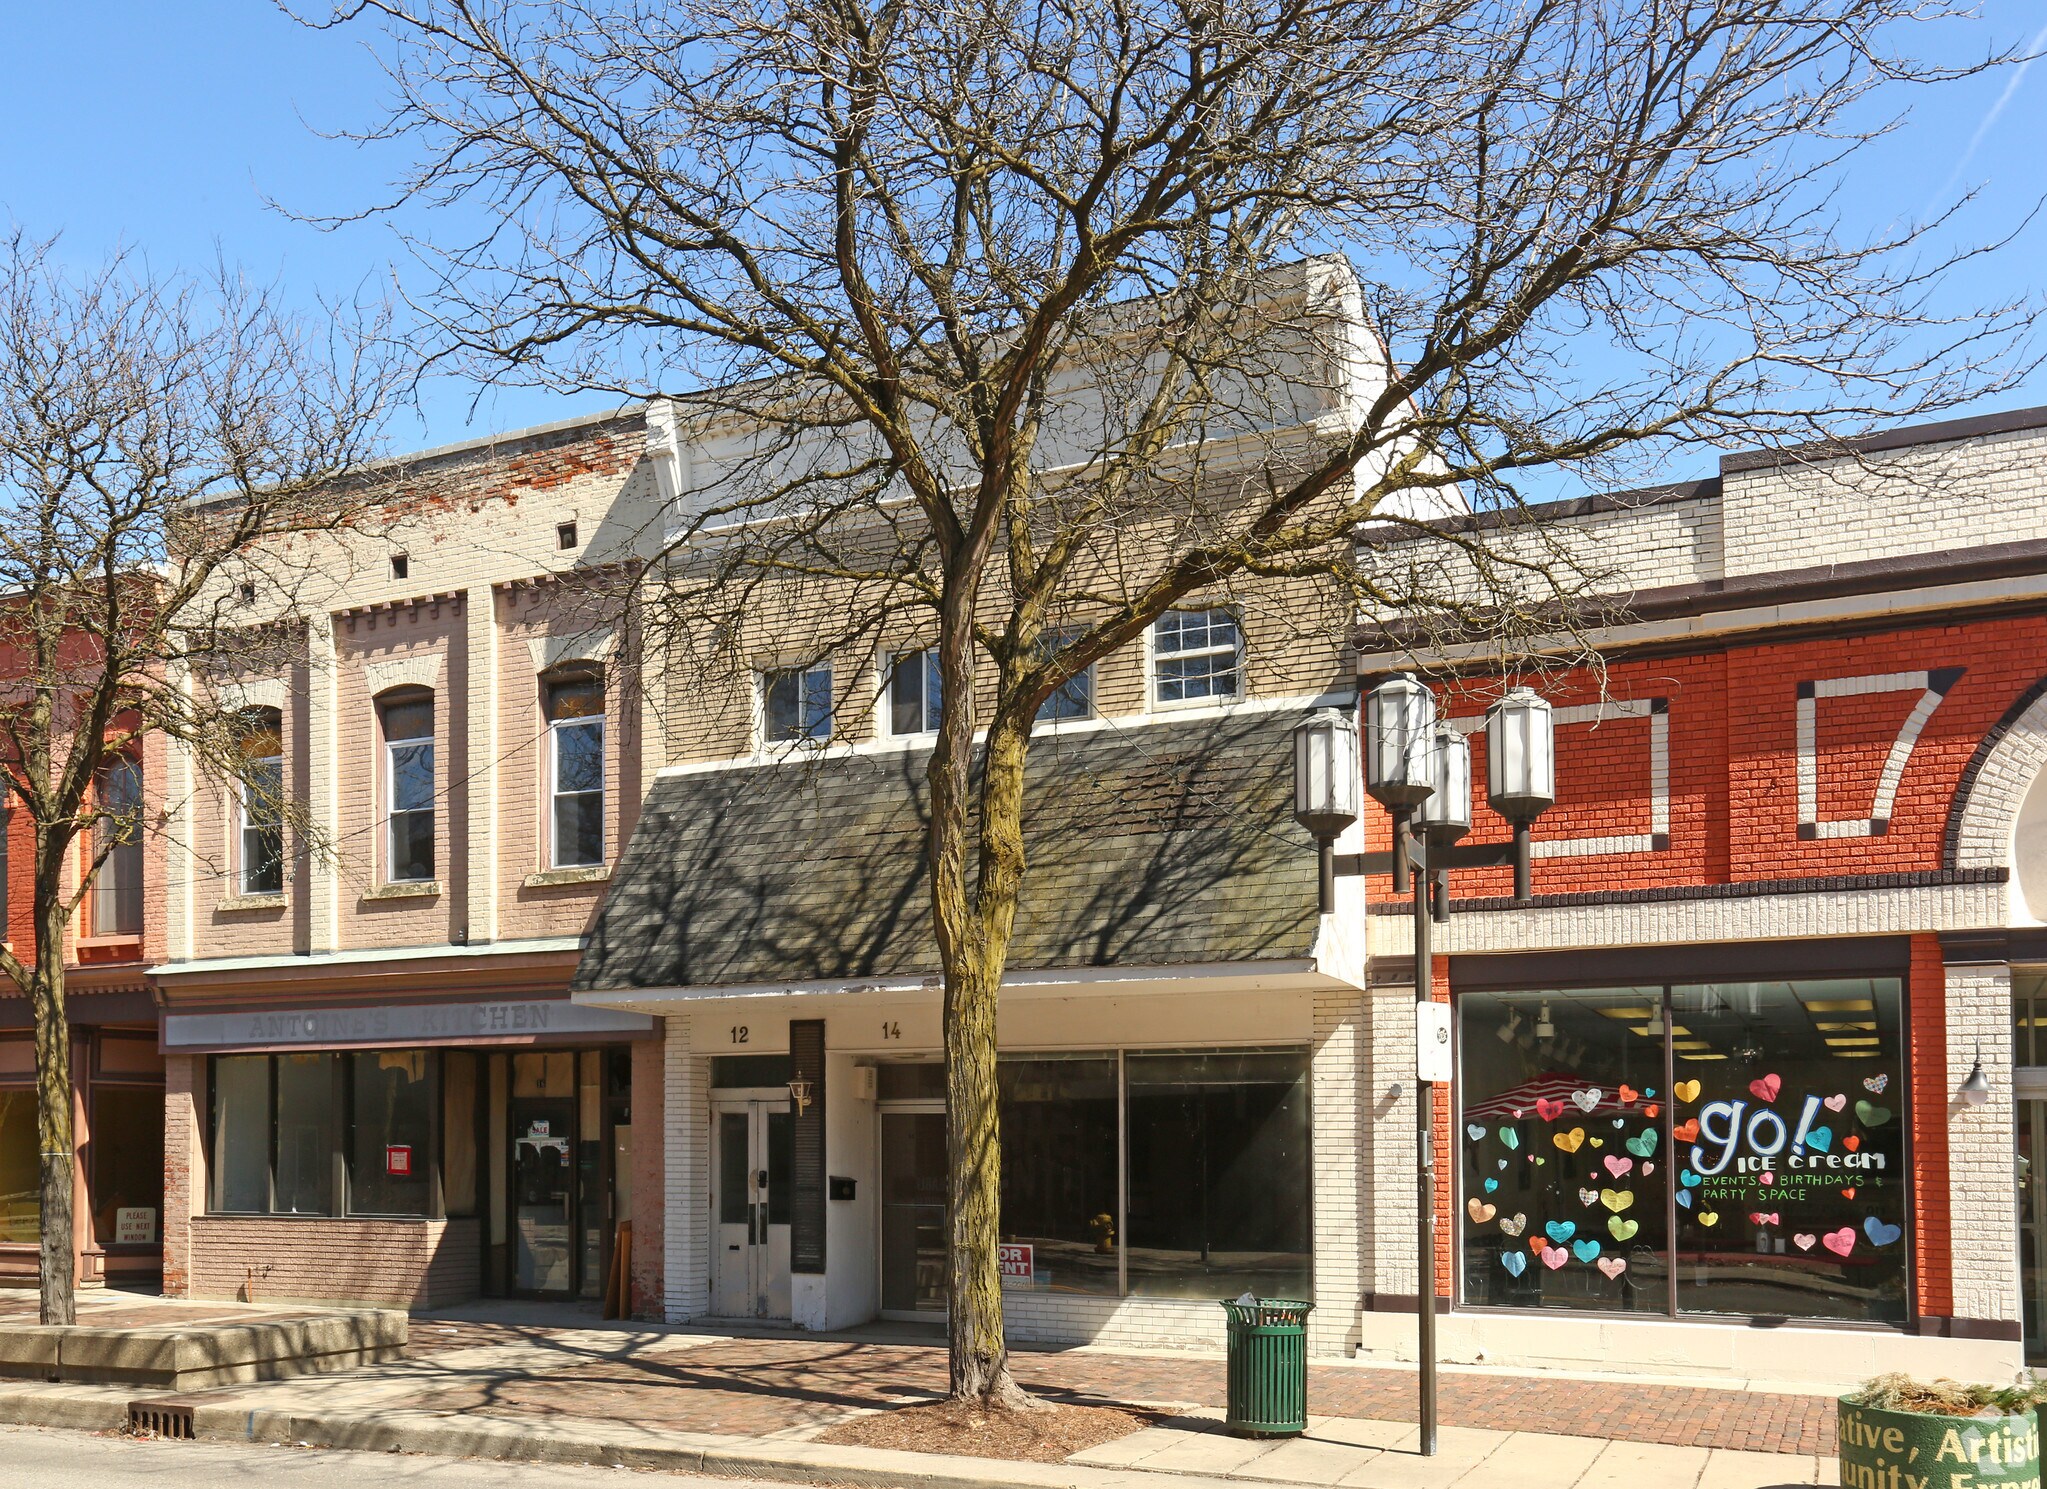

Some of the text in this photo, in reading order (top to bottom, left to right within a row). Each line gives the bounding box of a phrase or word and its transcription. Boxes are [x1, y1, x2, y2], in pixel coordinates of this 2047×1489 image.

[421, 1004, 551, 1033] KITCHEN
[730, 1026, 749, 1044] 12
[882, 1021, 901, 1040] 14
[1690, 1094, 1823, 1176] go!
[1737, 1156, 1777, 1174] ICE
[1780, 1174, 1865, 1187] BIRTHDAYS
[1703, 1188, 1806, 1201] PARTY SPACE
[126, 1211, 147, 1220] PLEASE
[120, 1222, 150, 1231] USE NEXT
[123, 1233, 147, 1241] WINDOW
[998, 1247, 1022, 1261] OR
[998, 1261, 1028, 1275] ENT
